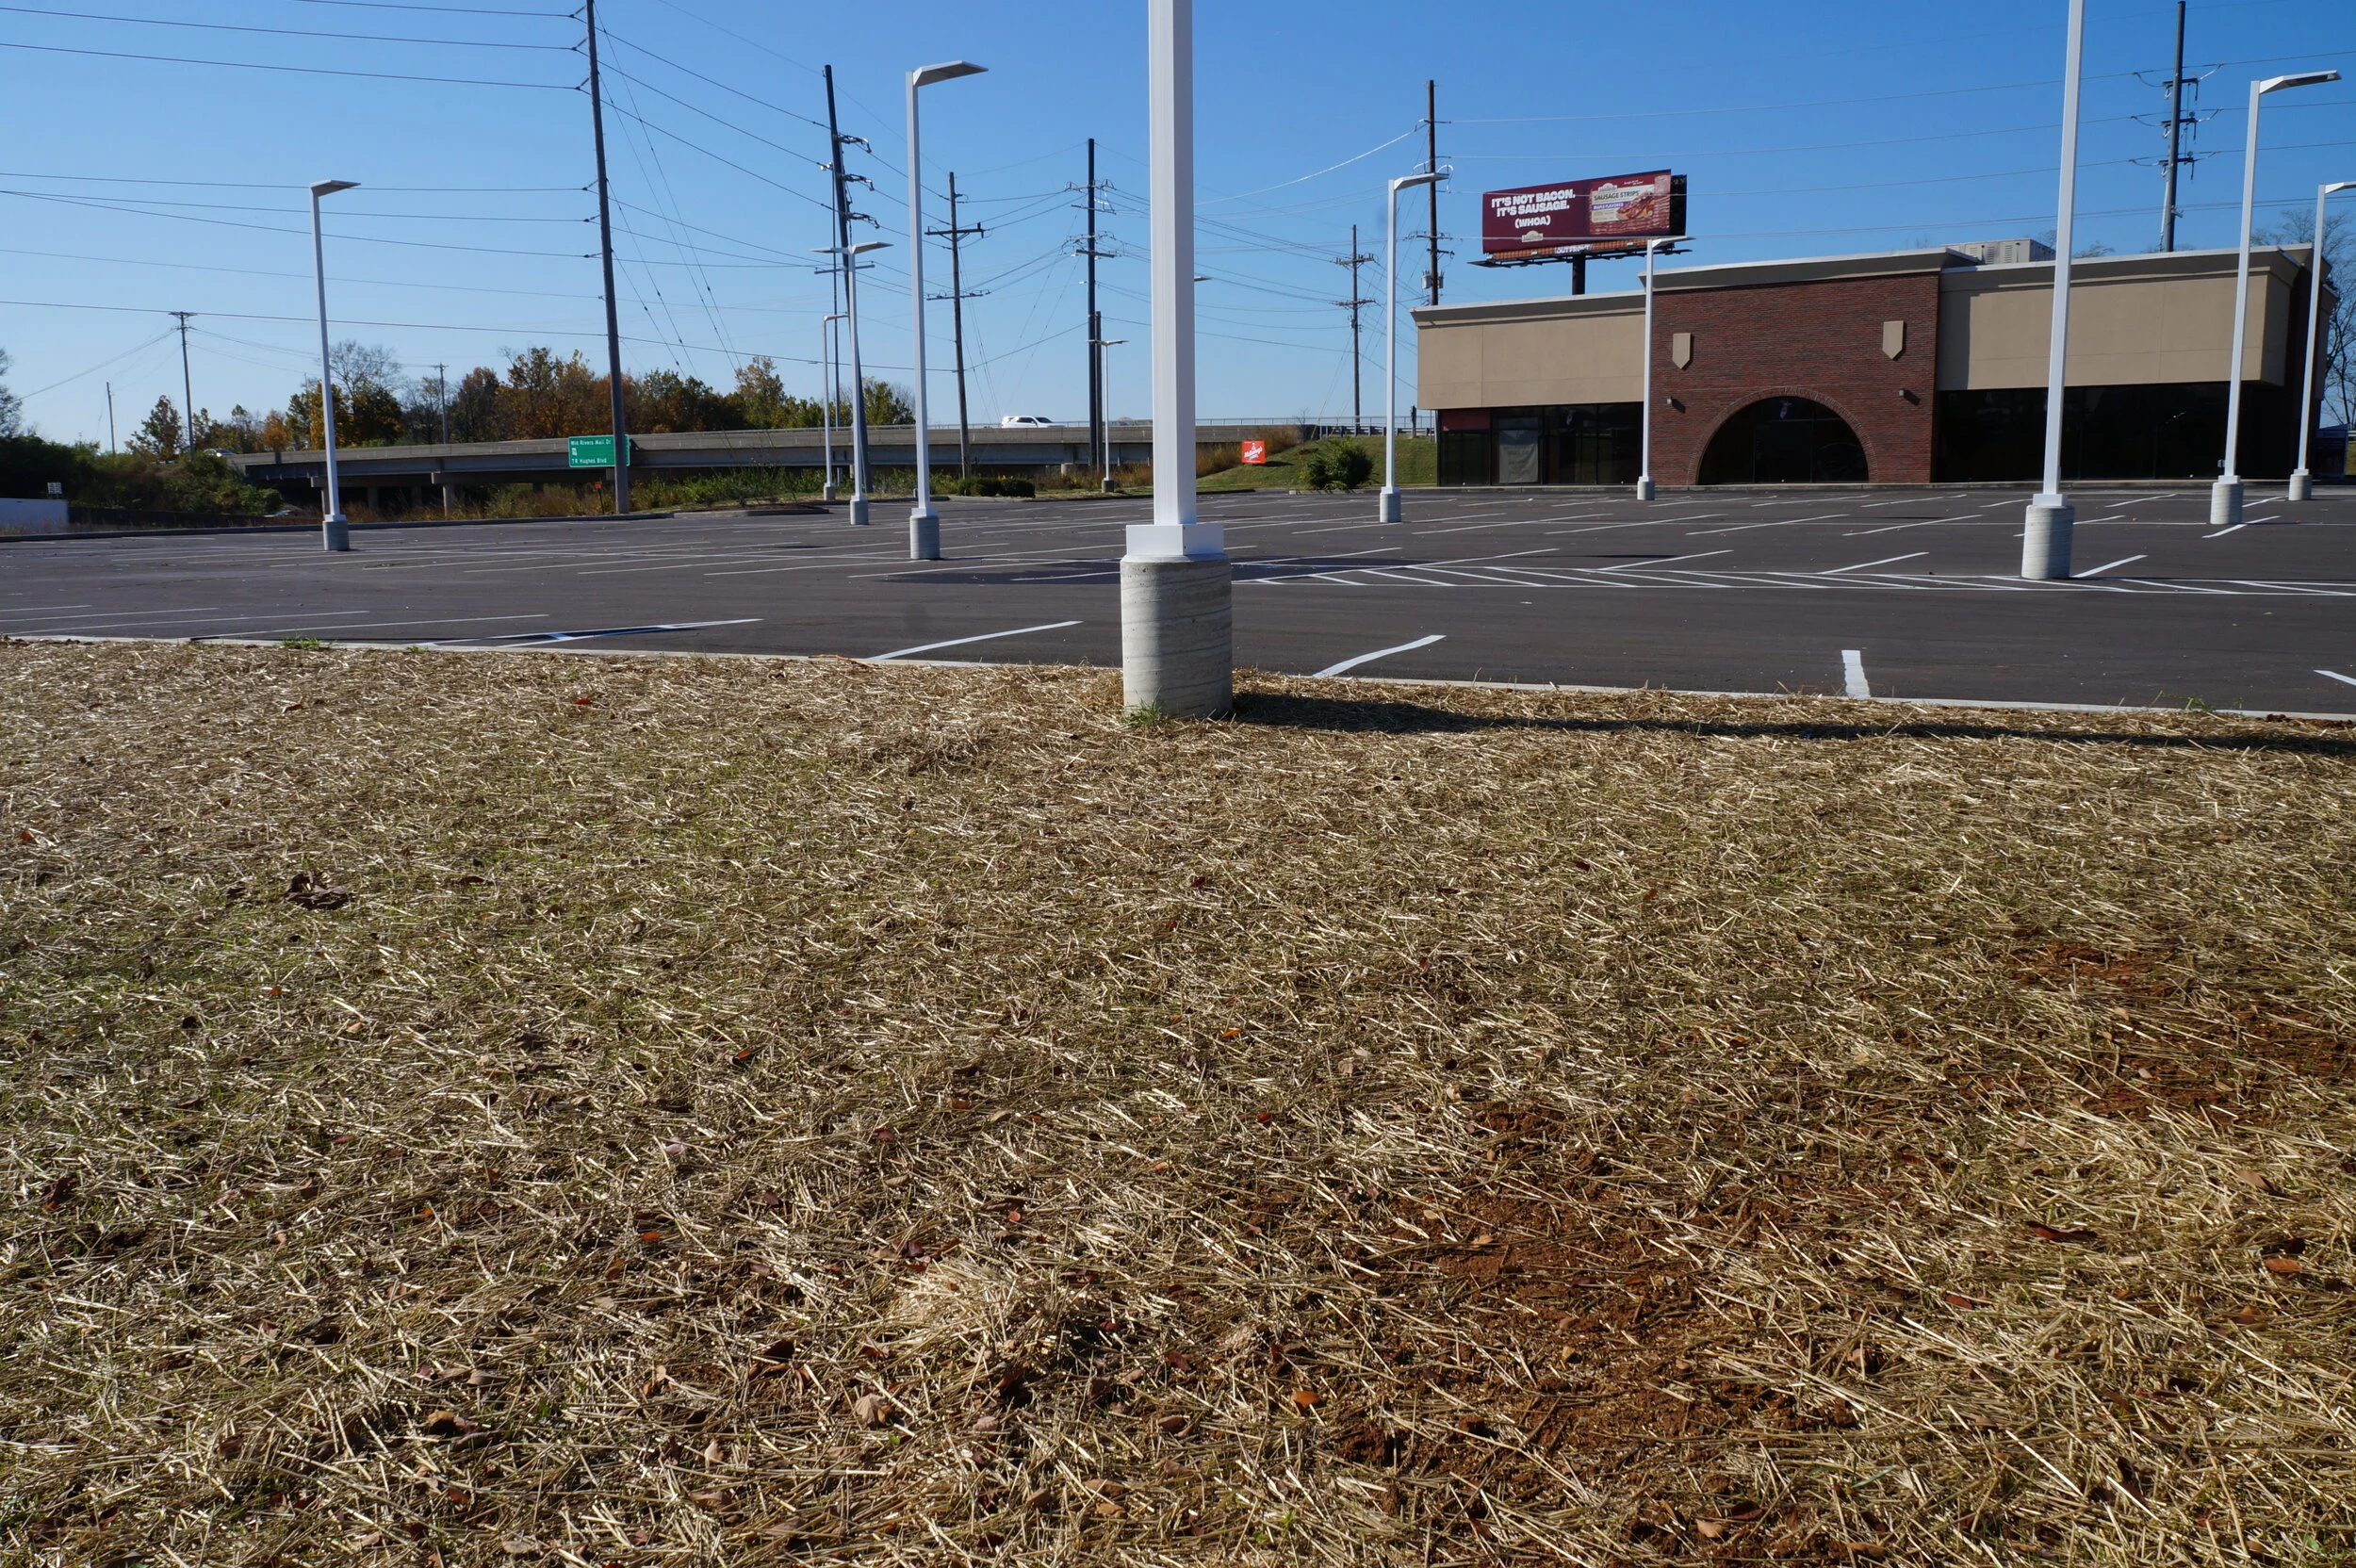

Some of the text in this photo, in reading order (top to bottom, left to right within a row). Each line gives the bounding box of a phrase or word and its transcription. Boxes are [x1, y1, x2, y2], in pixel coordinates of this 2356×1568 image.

[1491, 188, 1576, 208] IT'S NOT BACON.
[1594, 190, 1639, 201] SAUSAGE STRIPS
[1497, 200, 1570, 217] IT'S SAUSAGE.
[1514, 215, 1551, 229] (WHOA)
